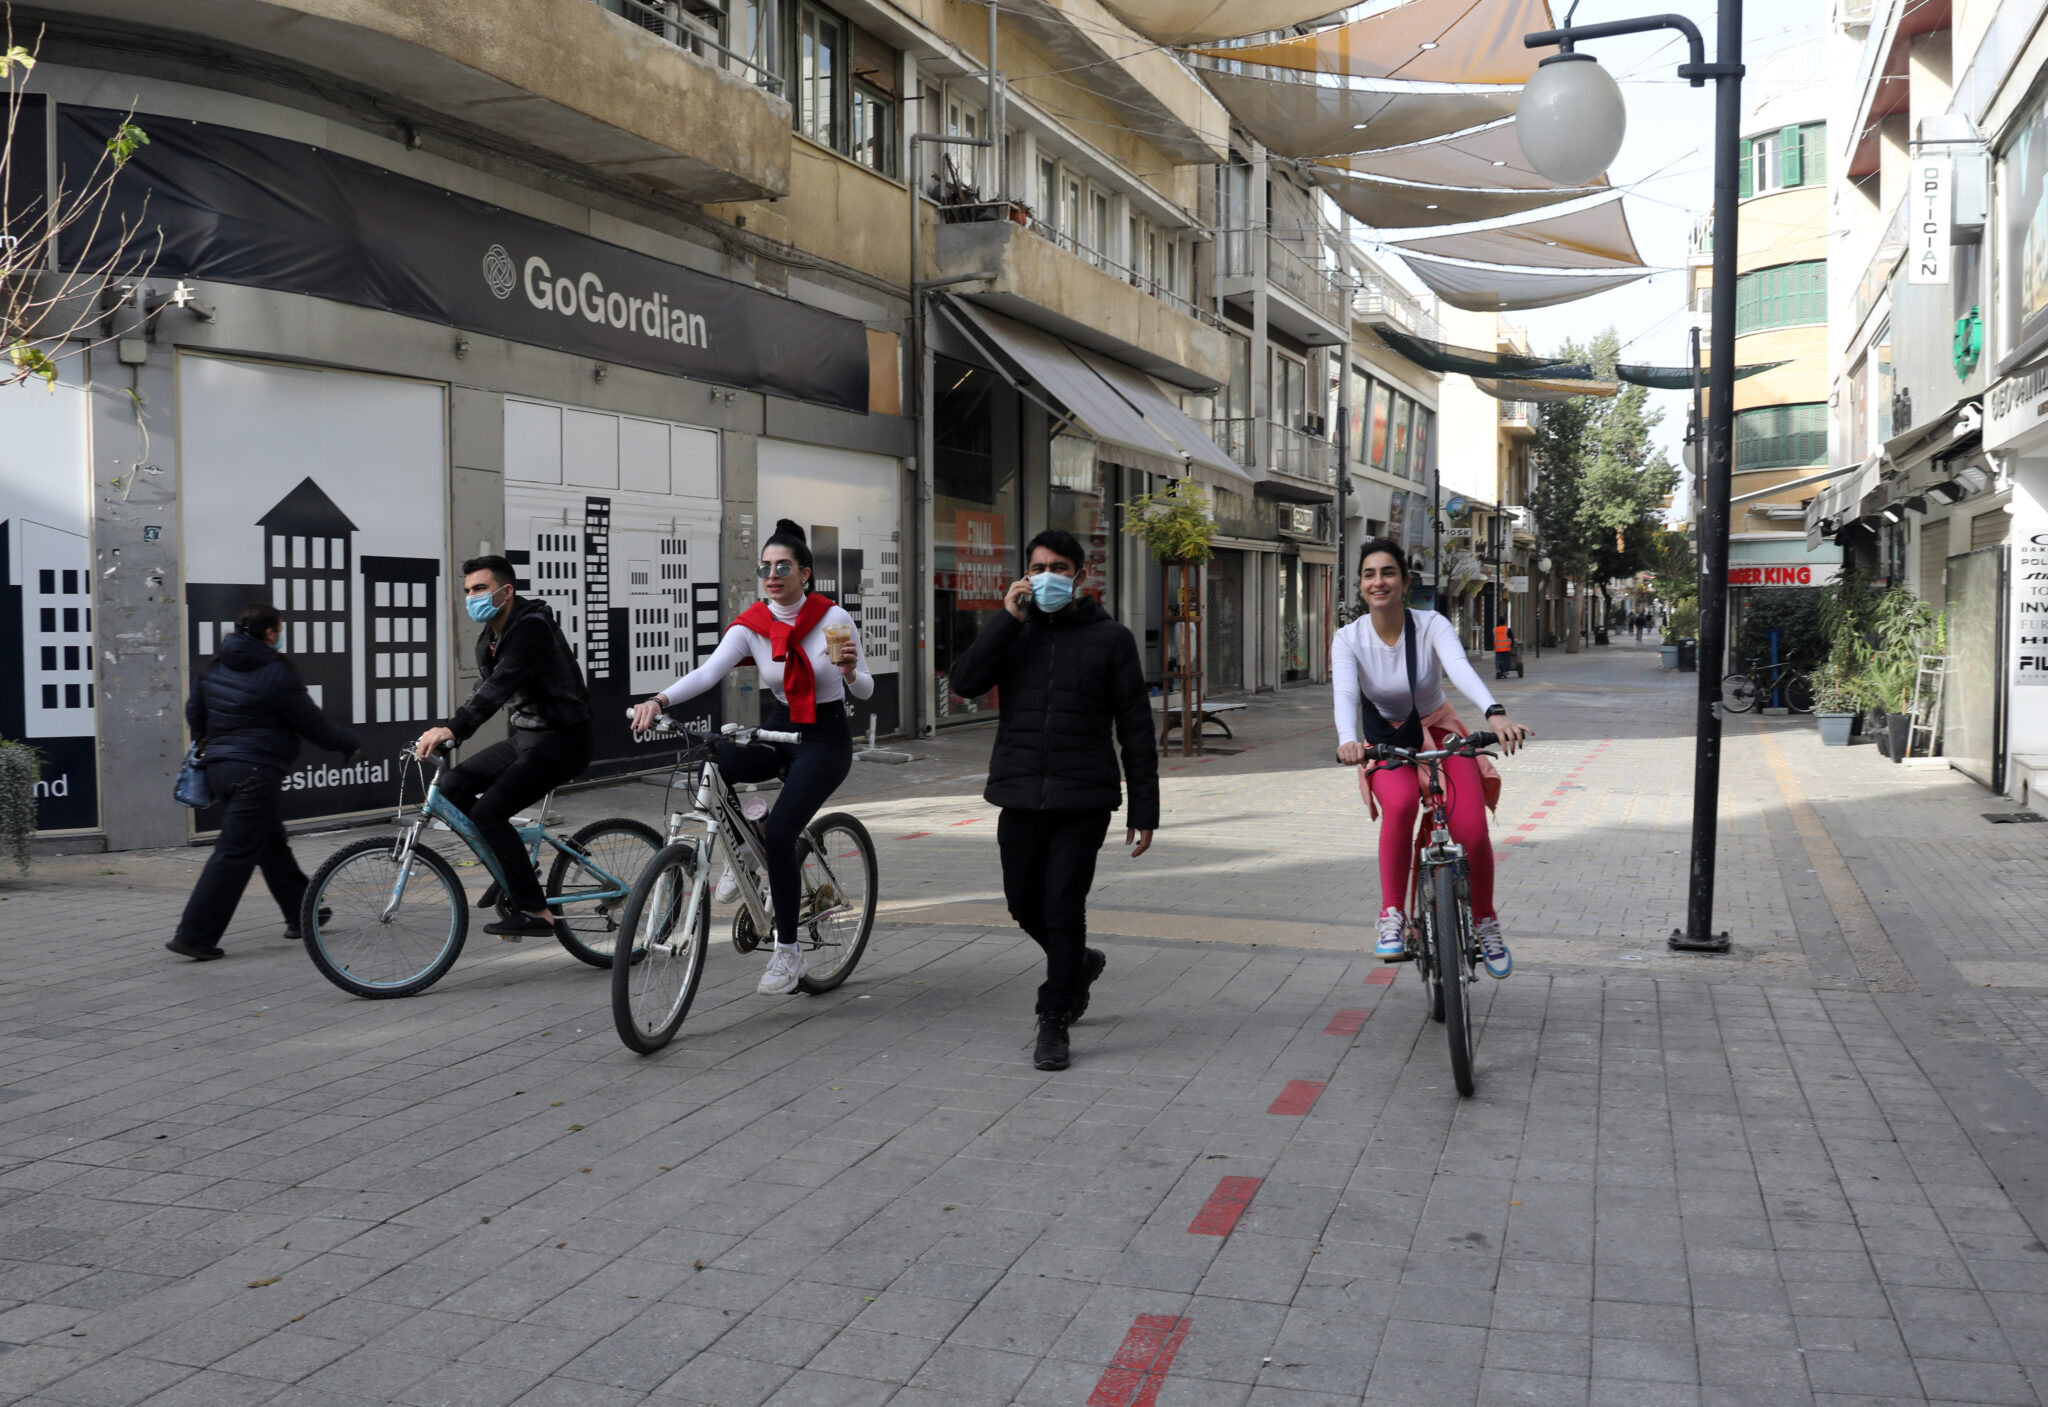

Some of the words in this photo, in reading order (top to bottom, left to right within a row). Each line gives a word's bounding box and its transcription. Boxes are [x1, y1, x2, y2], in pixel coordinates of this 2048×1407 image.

[1921, 167, 1939, 276] OPTICIAN
[524, 255, 708, 349] GoGordian
[1764, 566, 1811, 585] KING
[2020, 656, 2048, 671] FIL
[281, 759, 389, 791] esidential
